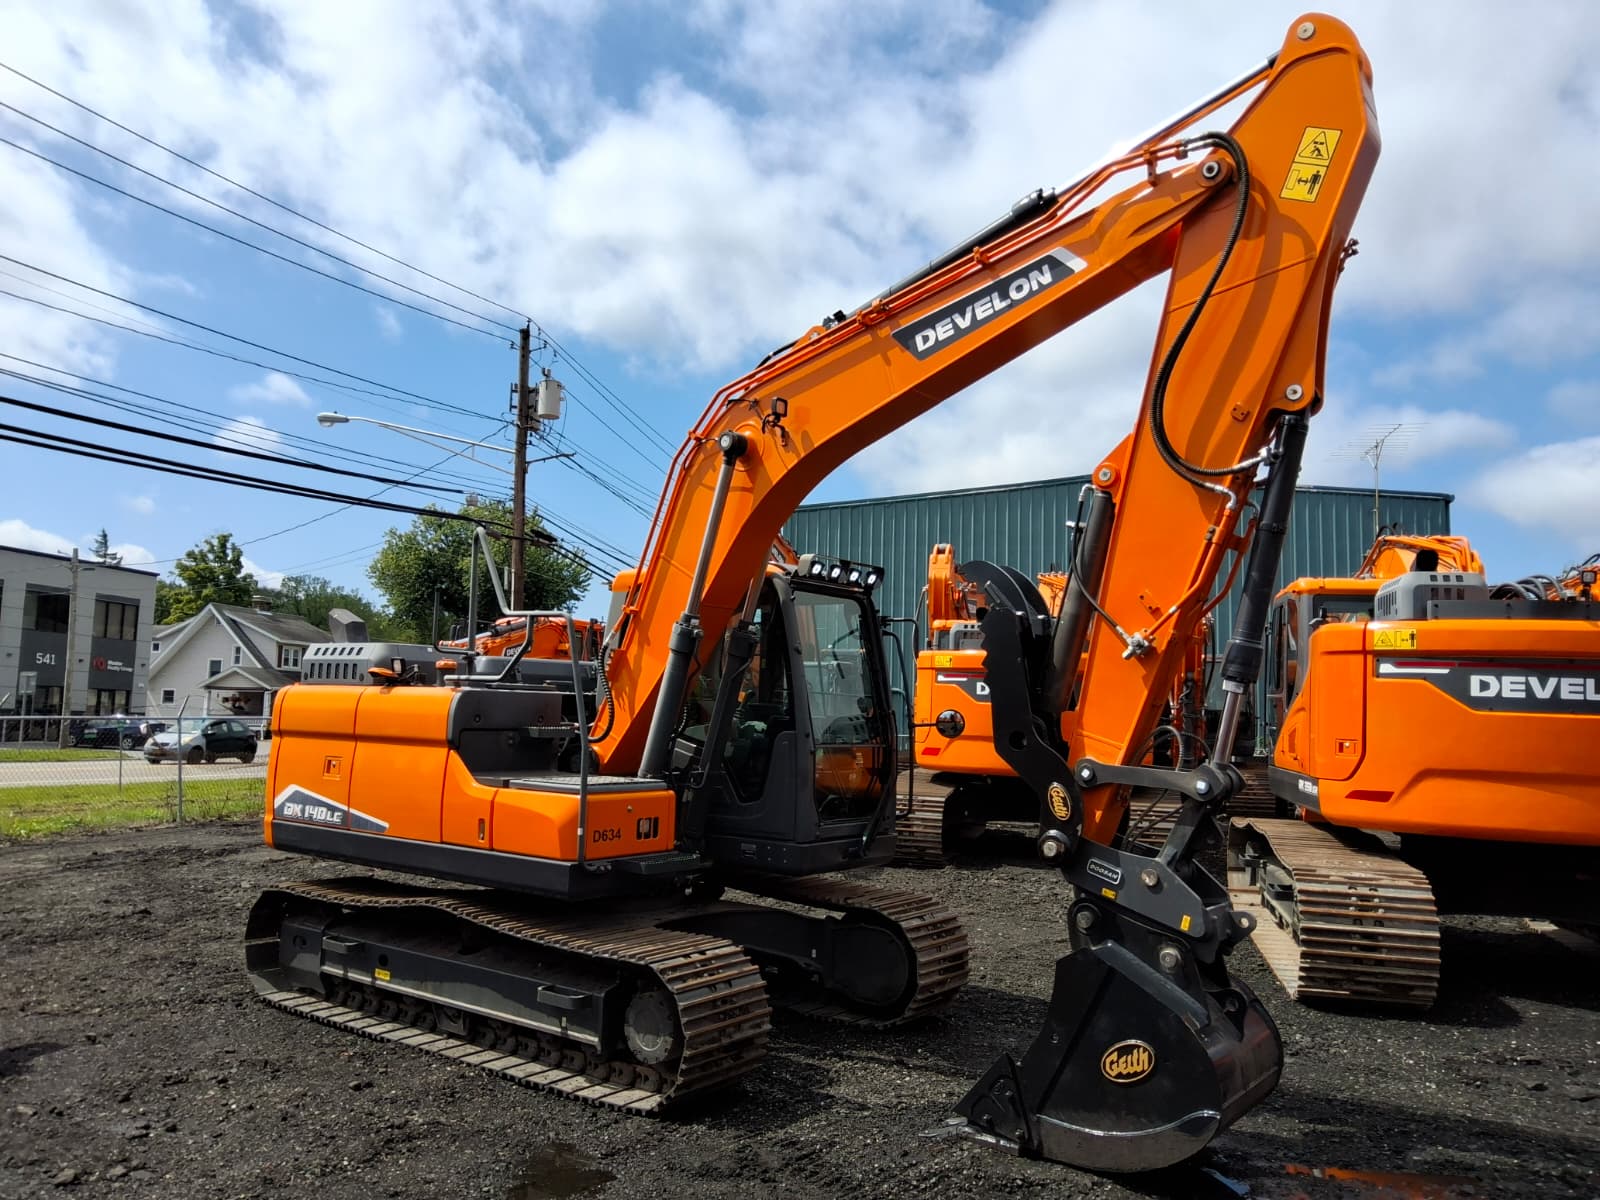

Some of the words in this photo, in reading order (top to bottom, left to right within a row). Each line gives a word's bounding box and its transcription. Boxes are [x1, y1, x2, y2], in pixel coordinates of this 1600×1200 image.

[914, 264, 1053, 352] DEVELON
[35, 652, 56, 665] 541
[593, 828, 621, 843] D634
[1089, 863, 1119, 879] DOOSAN
